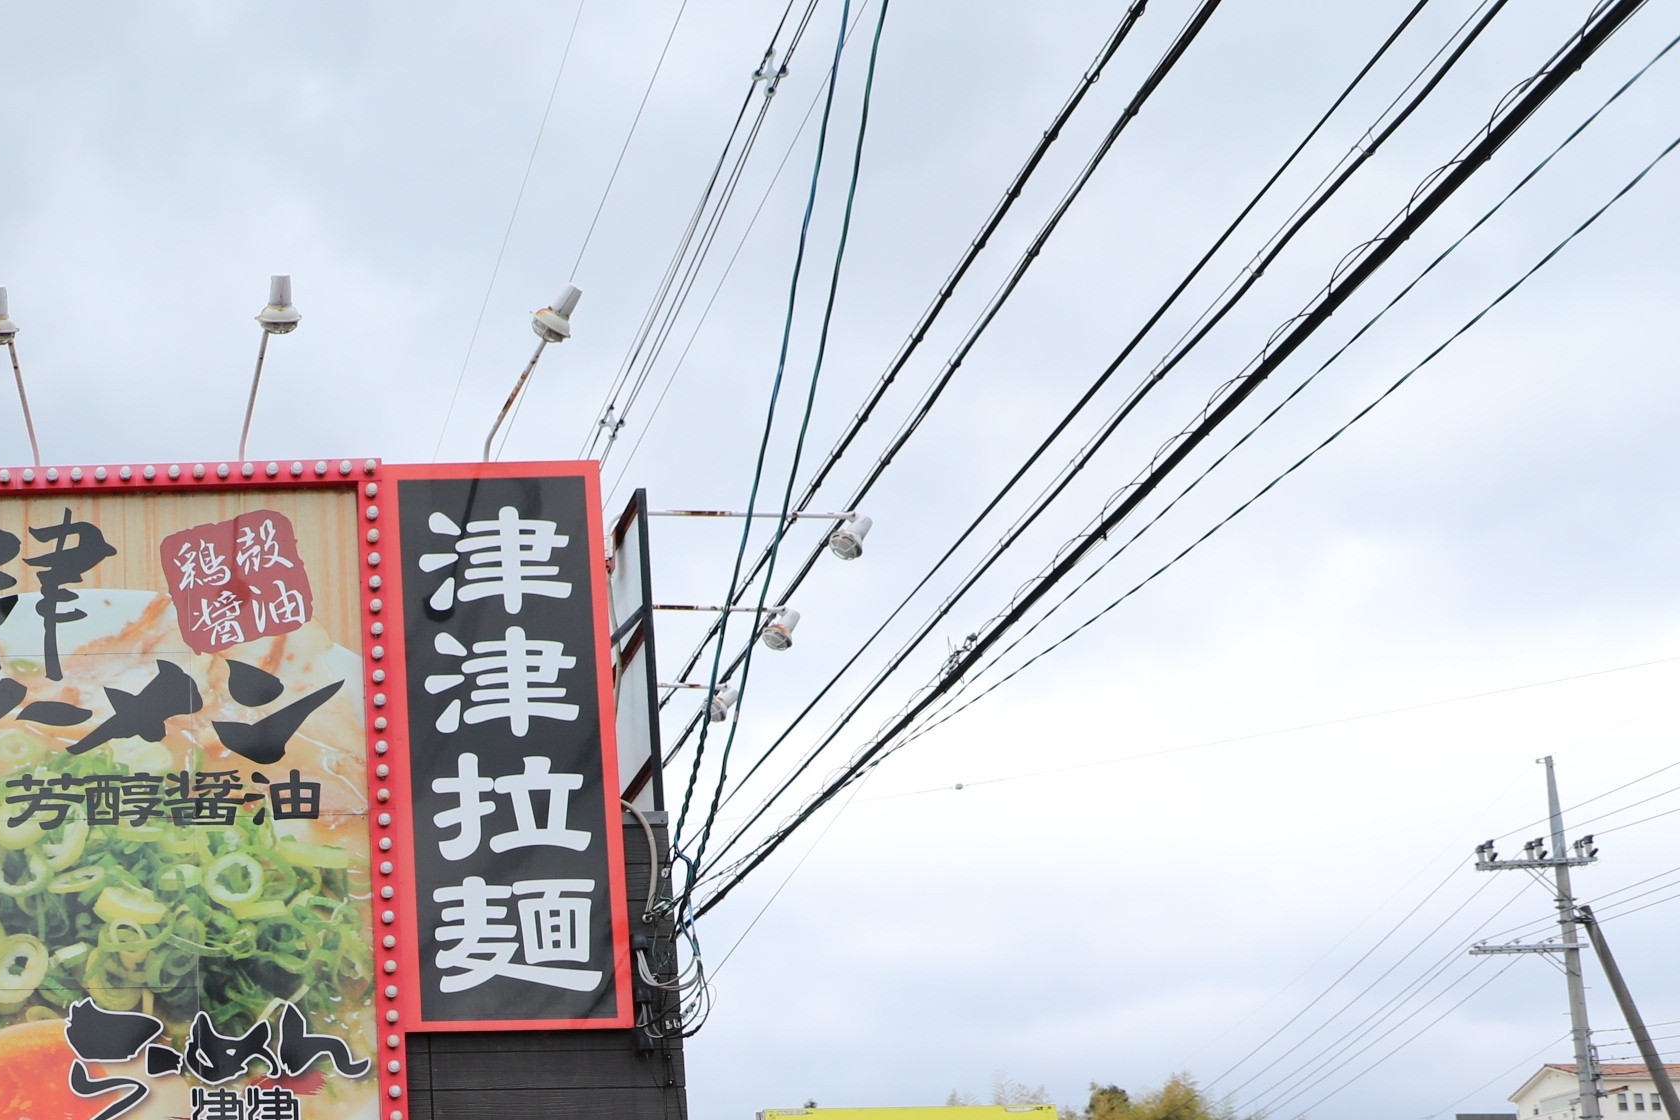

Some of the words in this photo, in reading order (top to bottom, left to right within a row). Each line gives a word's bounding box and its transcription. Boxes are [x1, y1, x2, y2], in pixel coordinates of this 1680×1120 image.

[5, 769, 321, 831] 芳醇醤油
[419, 506, 603, 993] 津津拉麺
